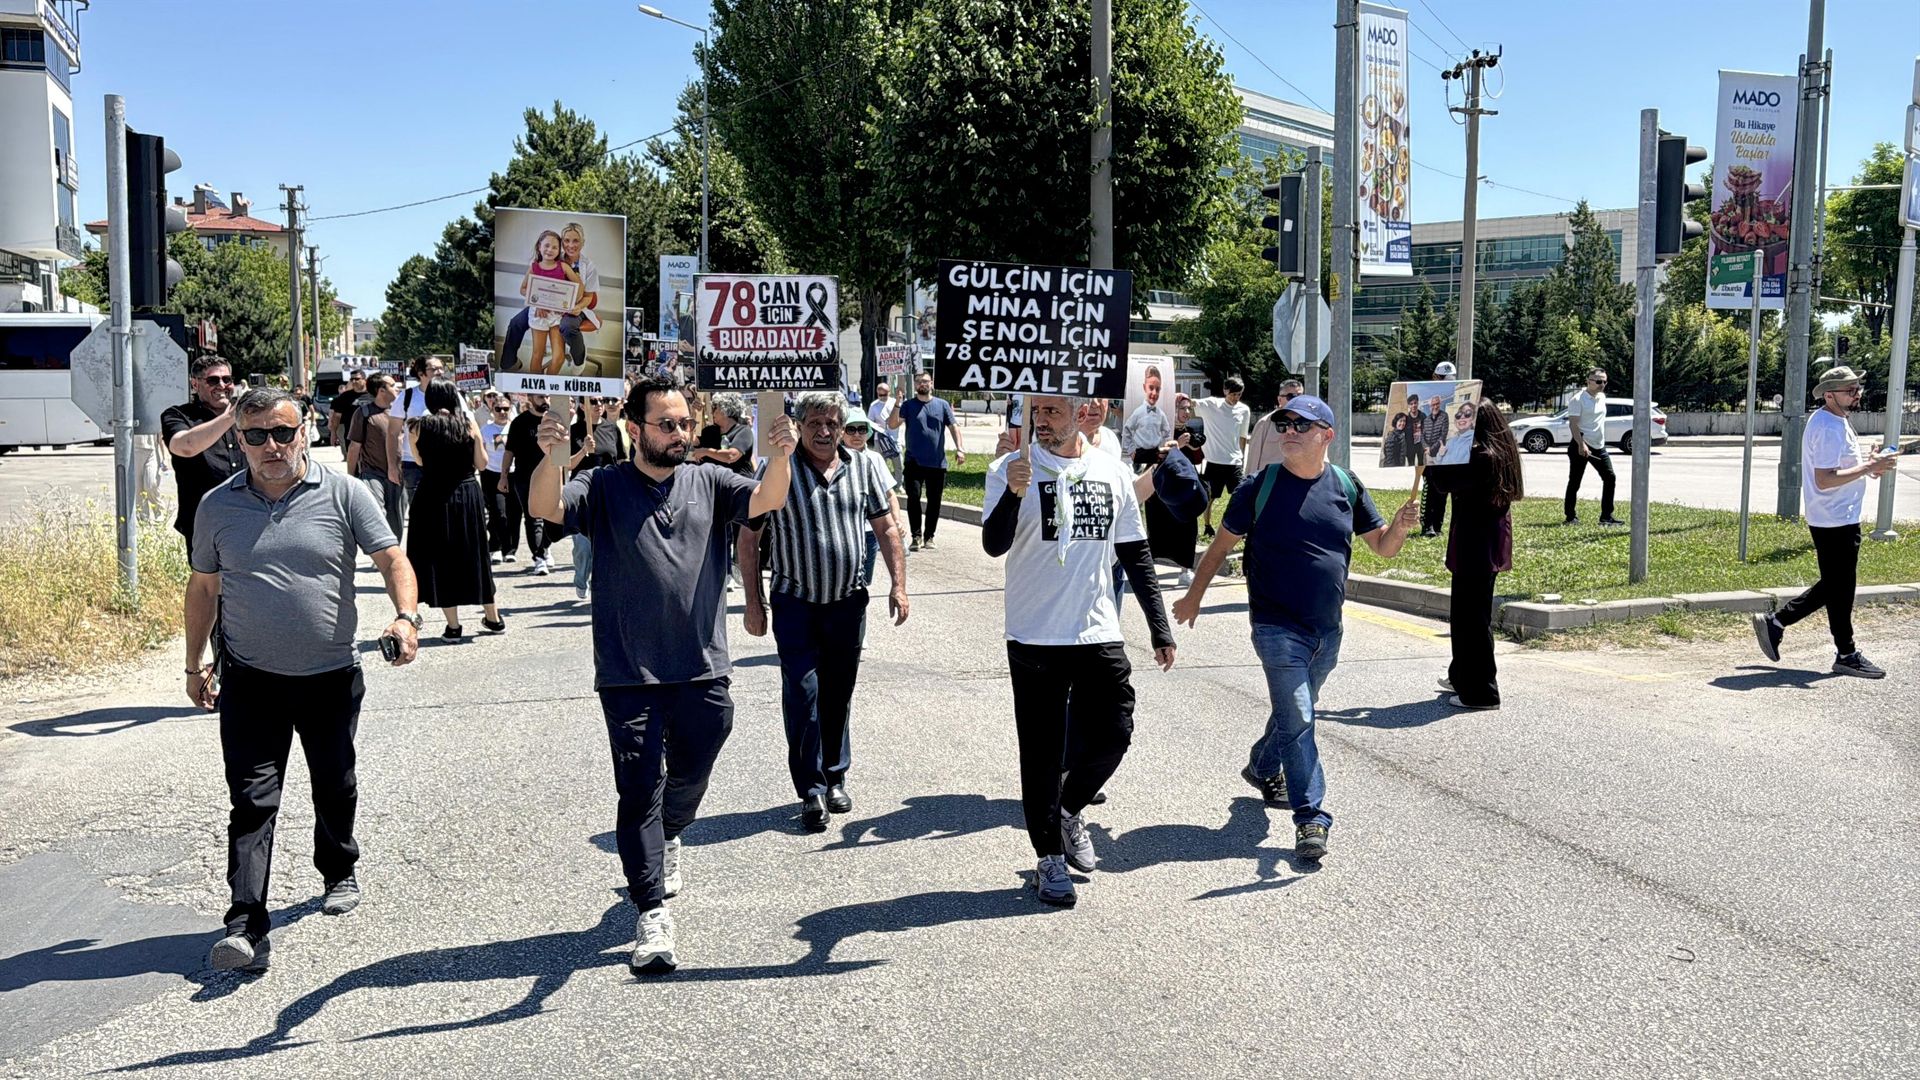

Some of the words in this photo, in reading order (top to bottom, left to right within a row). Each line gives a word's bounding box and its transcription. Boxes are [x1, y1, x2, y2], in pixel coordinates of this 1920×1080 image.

[1368, 24, 1397, 46] MADO
[1733, 89, 1780, 107] MADO
[1734, 119, 1746, 129] Bu
[1748, 120, 1776, 133] Hikaye
[668, 261, 691, 269] MADO
[948, 262, 1051, 294] GÜLÇİN
[1060, 268, 1114, 298] İÇİN
[705, 281, 757, 327] 78
[759, 281, 800, 305] CAN
[967, 292, 1041, 319] MİNA
[1051, 295, 1105, 325] İÇİN
[767, 307, 793, 325] İÇİN
[719, 329, 817, 350] BURADAYIZ
[962, 319, 1053, 345] ŞENOL
[1060, 322, 1111, 350] İÇİN
[880, 351, 905, 360] ADALET
[945, 343, 972, 361] 78
[978, 346, 1070, 367] CANIMIZ
[1077, 349, 1117, 371] İÇİN
[715, 366, 824, 381] KARTALKAYA
[959, 363, 1103, 395] ADALET
[521, 378, 546, 391] ALYA
[549, 383, 560, 391] ve
[564, 378, 602, 393] KÜBRA
[727, 380, 751, 389] AİLE
[757, 380, 815, 389] PLATFORMU
[1086, 481, 1107, 494] İÇİN
[1085, 493, 1106, 505] İÇİN
[1090, 504, 1109, 517] İÇİN
